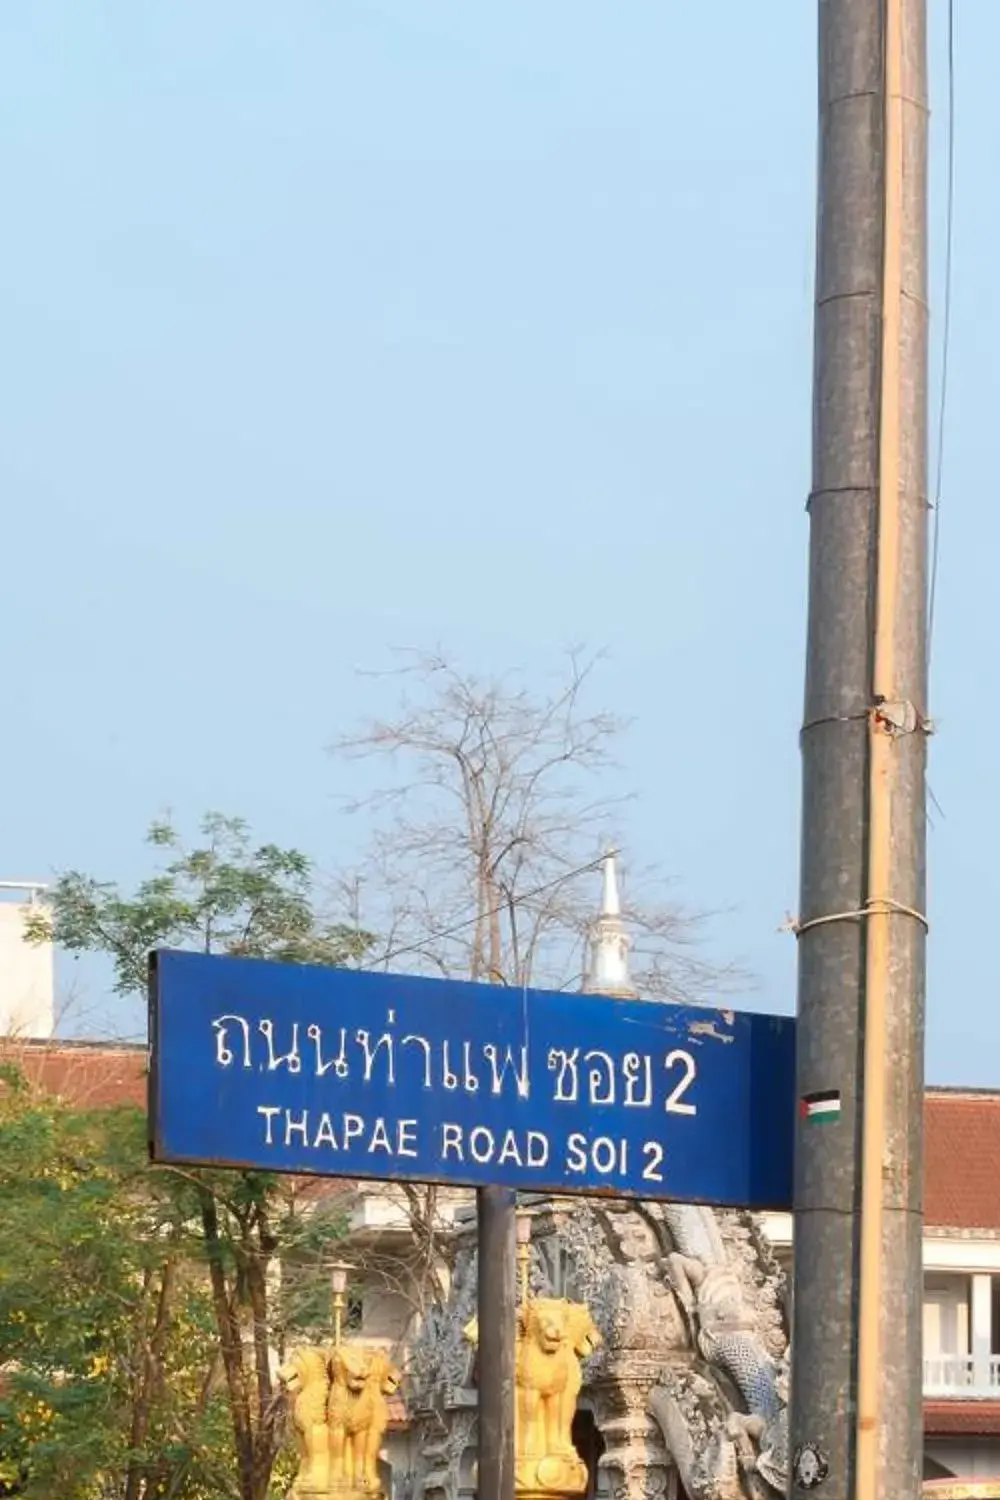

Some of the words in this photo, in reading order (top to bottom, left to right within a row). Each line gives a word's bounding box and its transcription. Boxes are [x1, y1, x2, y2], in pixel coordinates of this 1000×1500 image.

[212, 1009, 530, 1100] ถนนท่าแพ
[547, 1047, 652, 1107] ซอย
[664, 1049, 697, 1116] 2
[257, 1106, 418, 1158] THAPAE
[441, 1123, 550, 1168] ROAD
[565, 1132, 628, 1175] SOI
[642, 1141, 664, 1182] 2
